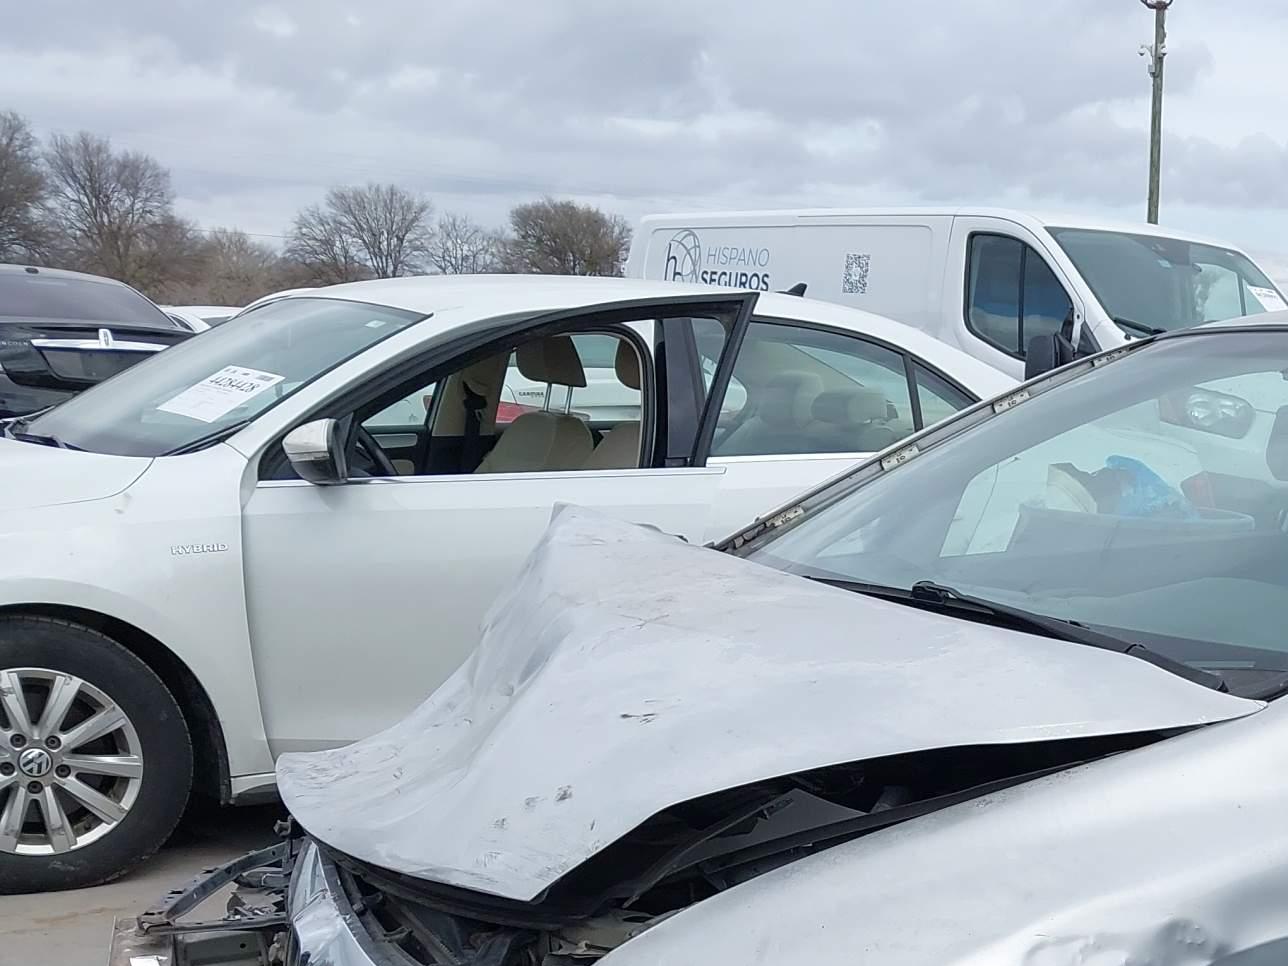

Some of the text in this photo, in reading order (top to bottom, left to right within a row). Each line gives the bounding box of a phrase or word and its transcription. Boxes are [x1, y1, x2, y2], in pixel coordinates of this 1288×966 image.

[706, 246, 770, 267] HISPANO
[701, 270, 769, 291] SEGUROS
[171, 544, 229, 555] HYBRID
